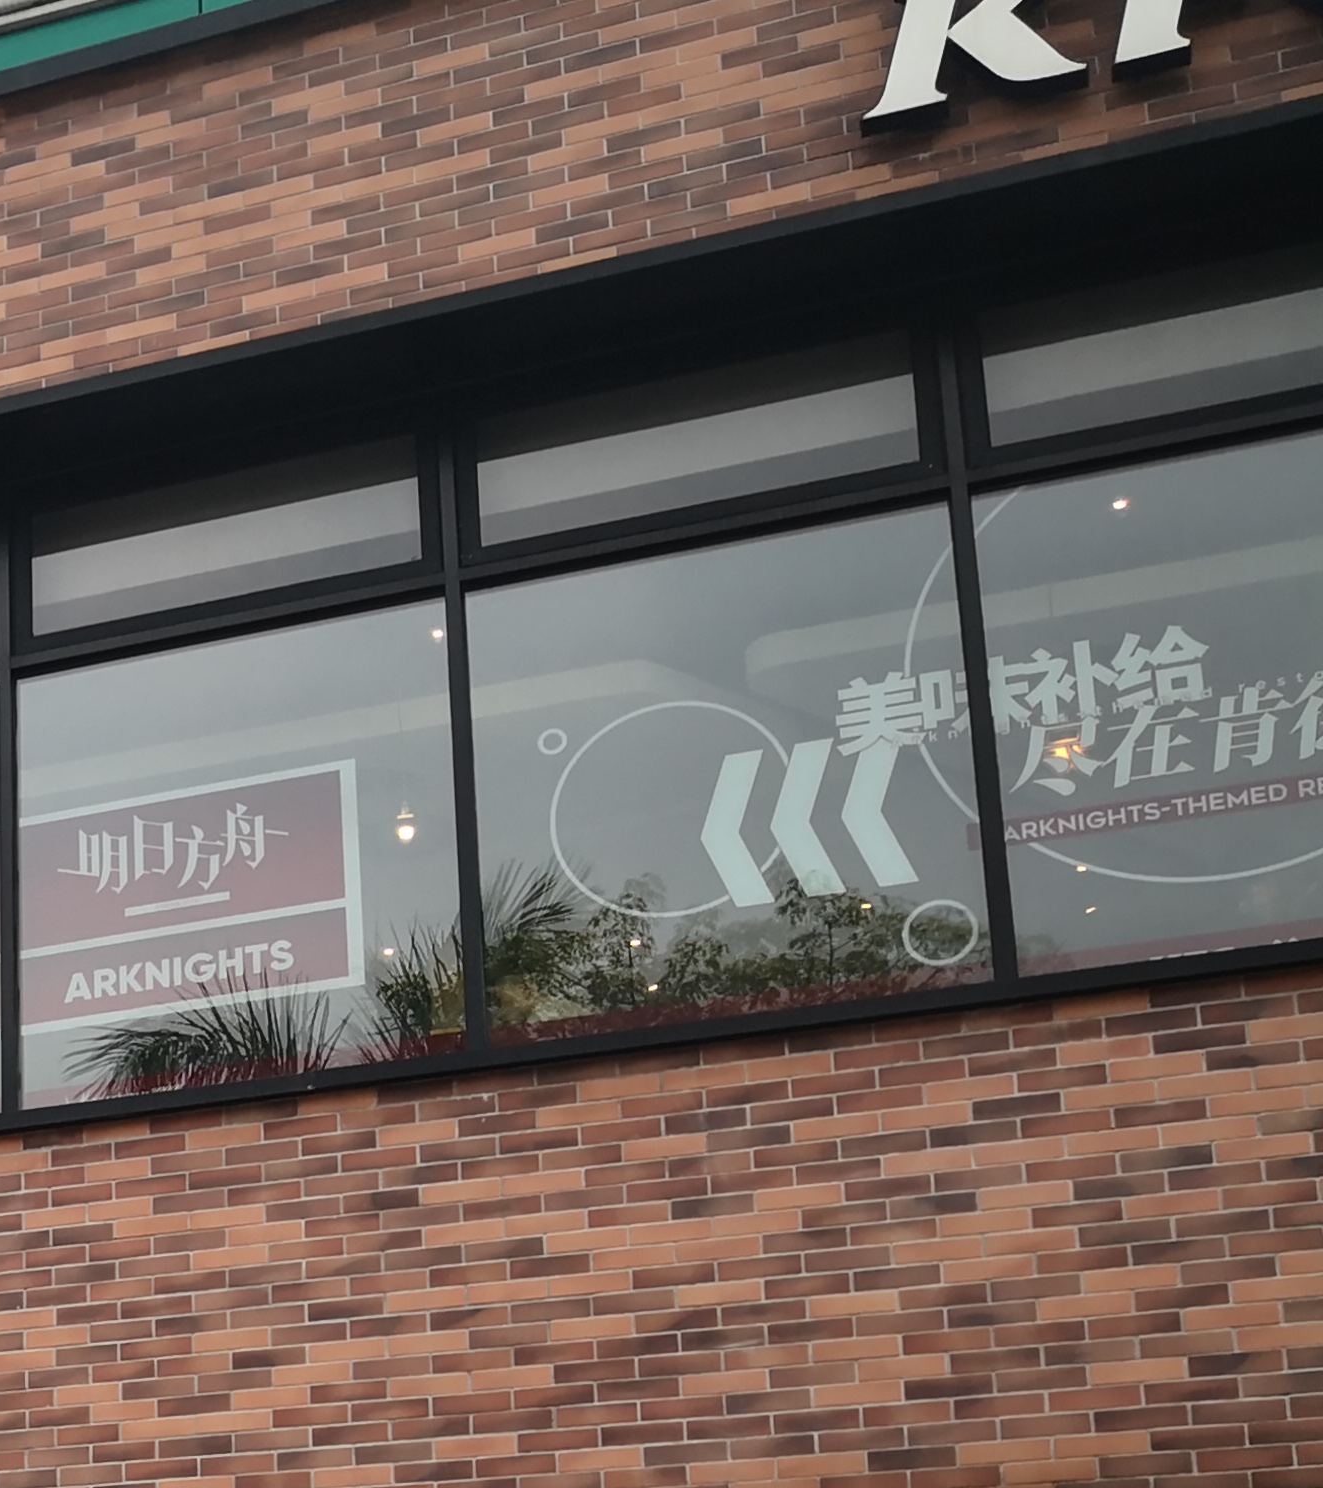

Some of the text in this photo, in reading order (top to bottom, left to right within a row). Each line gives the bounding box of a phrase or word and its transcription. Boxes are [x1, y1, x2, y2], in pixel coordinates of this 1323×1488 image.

[835, 625, 1210, 757] 美味补给
[58, 803, 289, 894] 明日方舟
[1004, 783, 1288, 844] ARKNIGHTS-THEMED
[64, 940, 295, 1004] ARKNIGHTS
